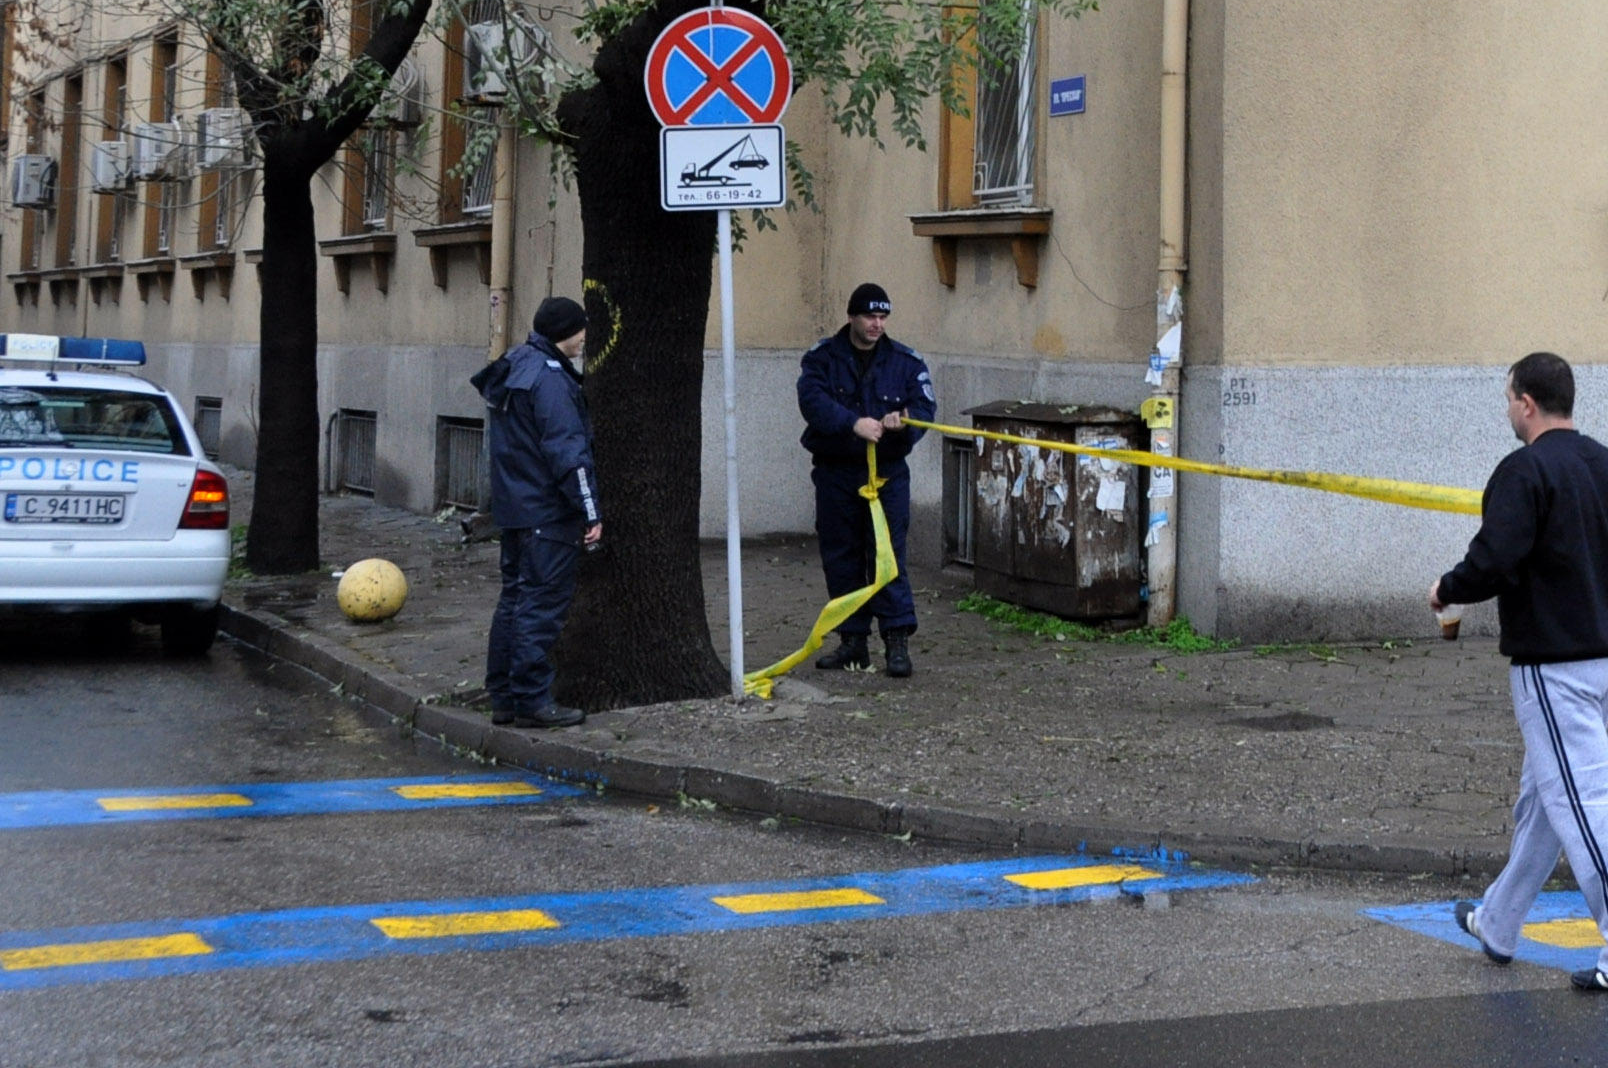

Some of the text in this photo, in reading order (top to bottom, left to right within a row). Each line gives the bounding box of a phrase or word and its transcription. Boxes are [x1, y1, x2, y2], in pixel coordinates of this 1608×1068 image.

[706, 189, 762, 200] 66-19-42
[1223, 392, 1256, 406] 2591
[0, 457, 139, 483] POLICE
